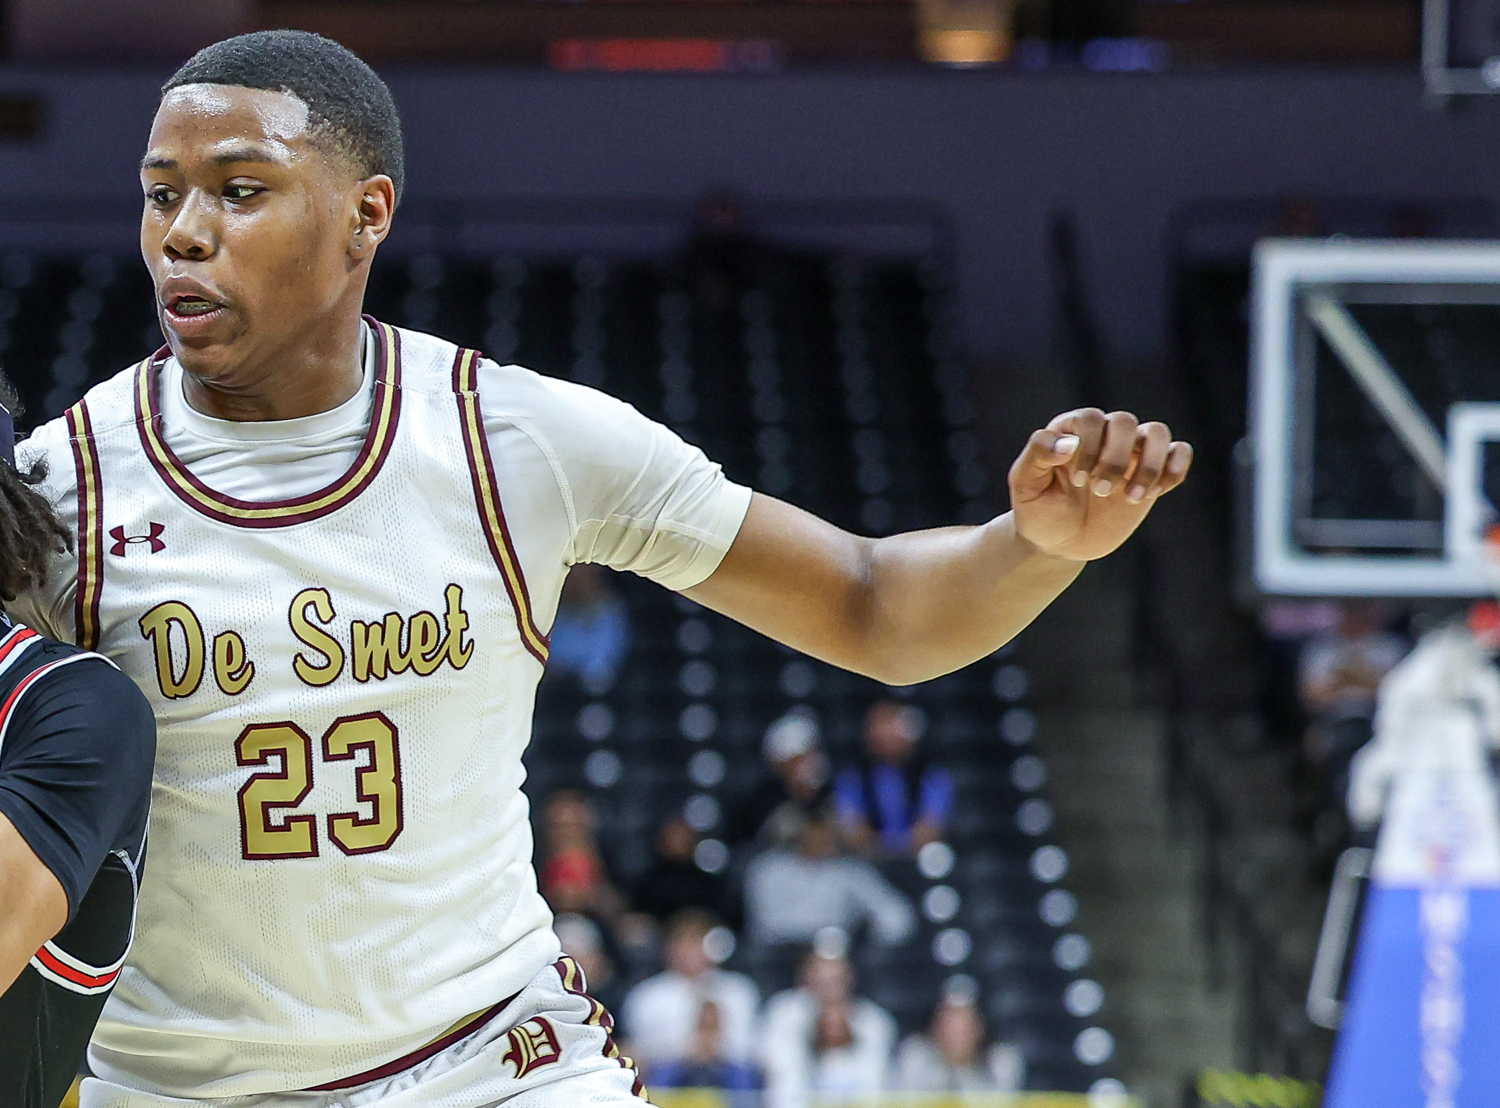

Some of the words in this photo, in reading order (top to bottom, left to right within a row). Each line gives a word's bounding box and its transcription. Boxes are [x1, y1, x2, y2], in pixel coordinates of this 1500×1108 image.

[138, 599, 255, 700] De
[289, 582, 475, 688] Smet
[234, 710, 404, 860] 23
